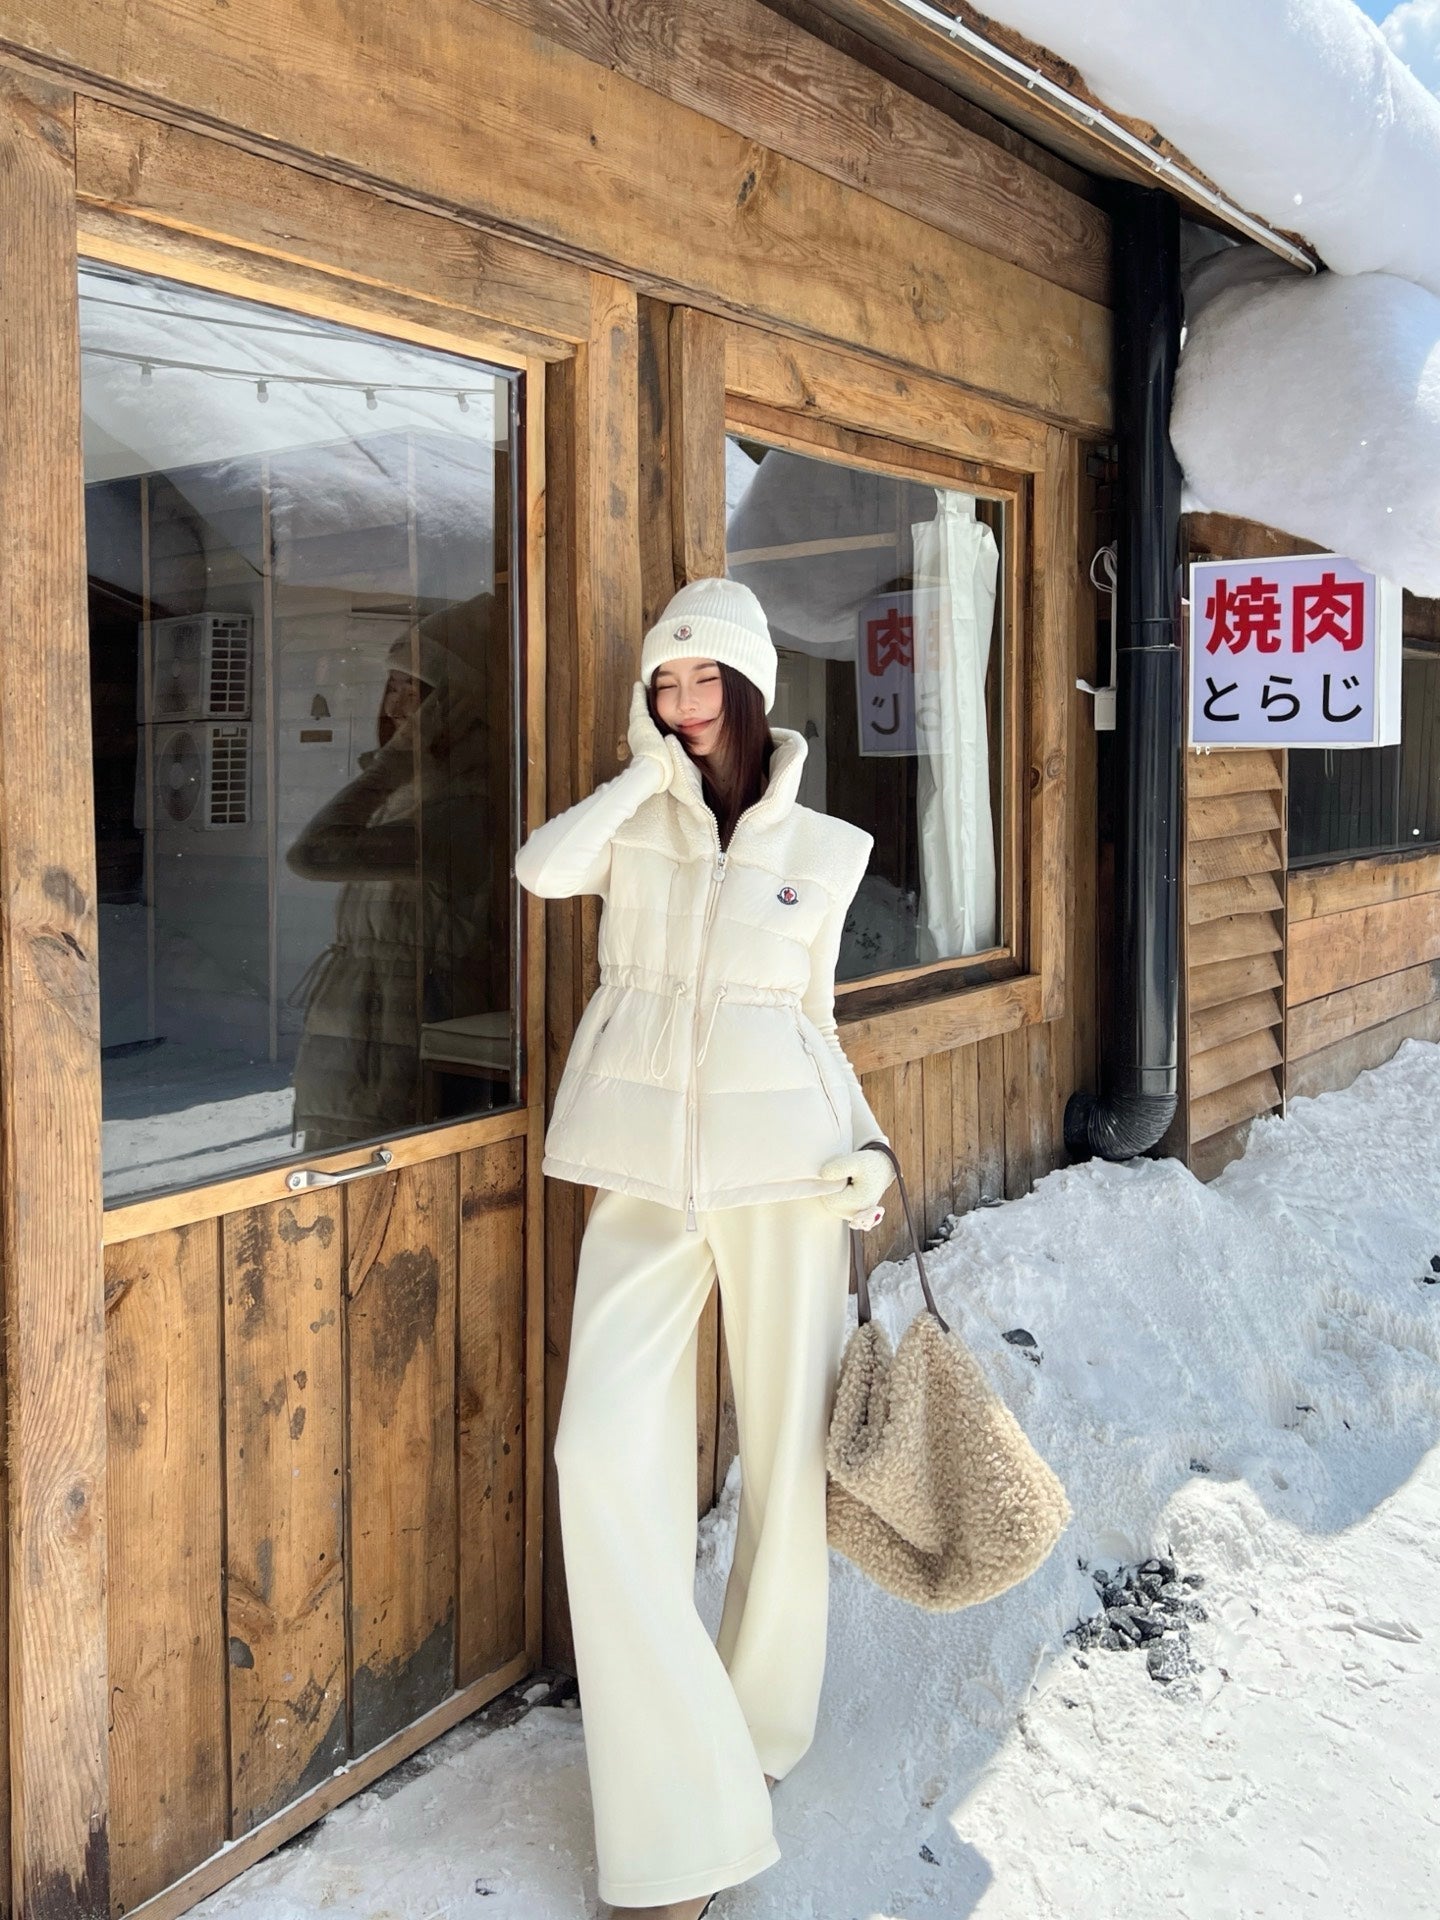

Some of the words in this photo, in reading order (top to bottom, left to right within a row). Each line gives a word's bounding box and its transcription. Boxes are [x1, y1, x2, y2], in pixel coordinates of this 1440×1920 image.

[1205, 572, 1364, 655] 焼肉
[1203, 674, 1363, 723] とらじ
